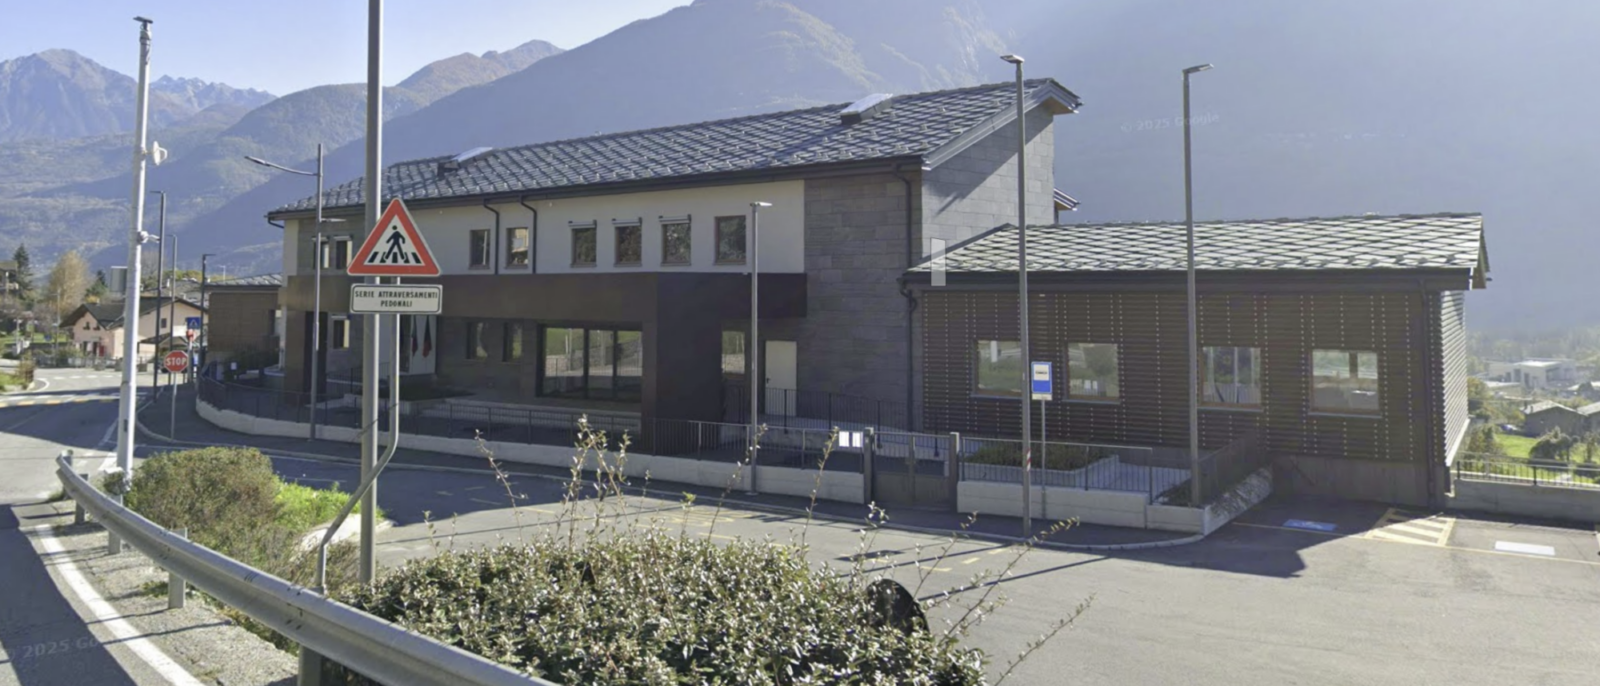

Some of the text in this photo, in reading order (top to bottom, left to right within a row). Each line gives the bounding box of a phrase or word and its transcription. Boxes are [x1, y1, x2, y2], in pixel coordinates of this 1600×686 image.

[355, 290, 438, 299] SERIE ATTRAVERSAMENTI
[380, 300, 413, 308] PEDONALI
[165, 357, 187, 366] STOP
